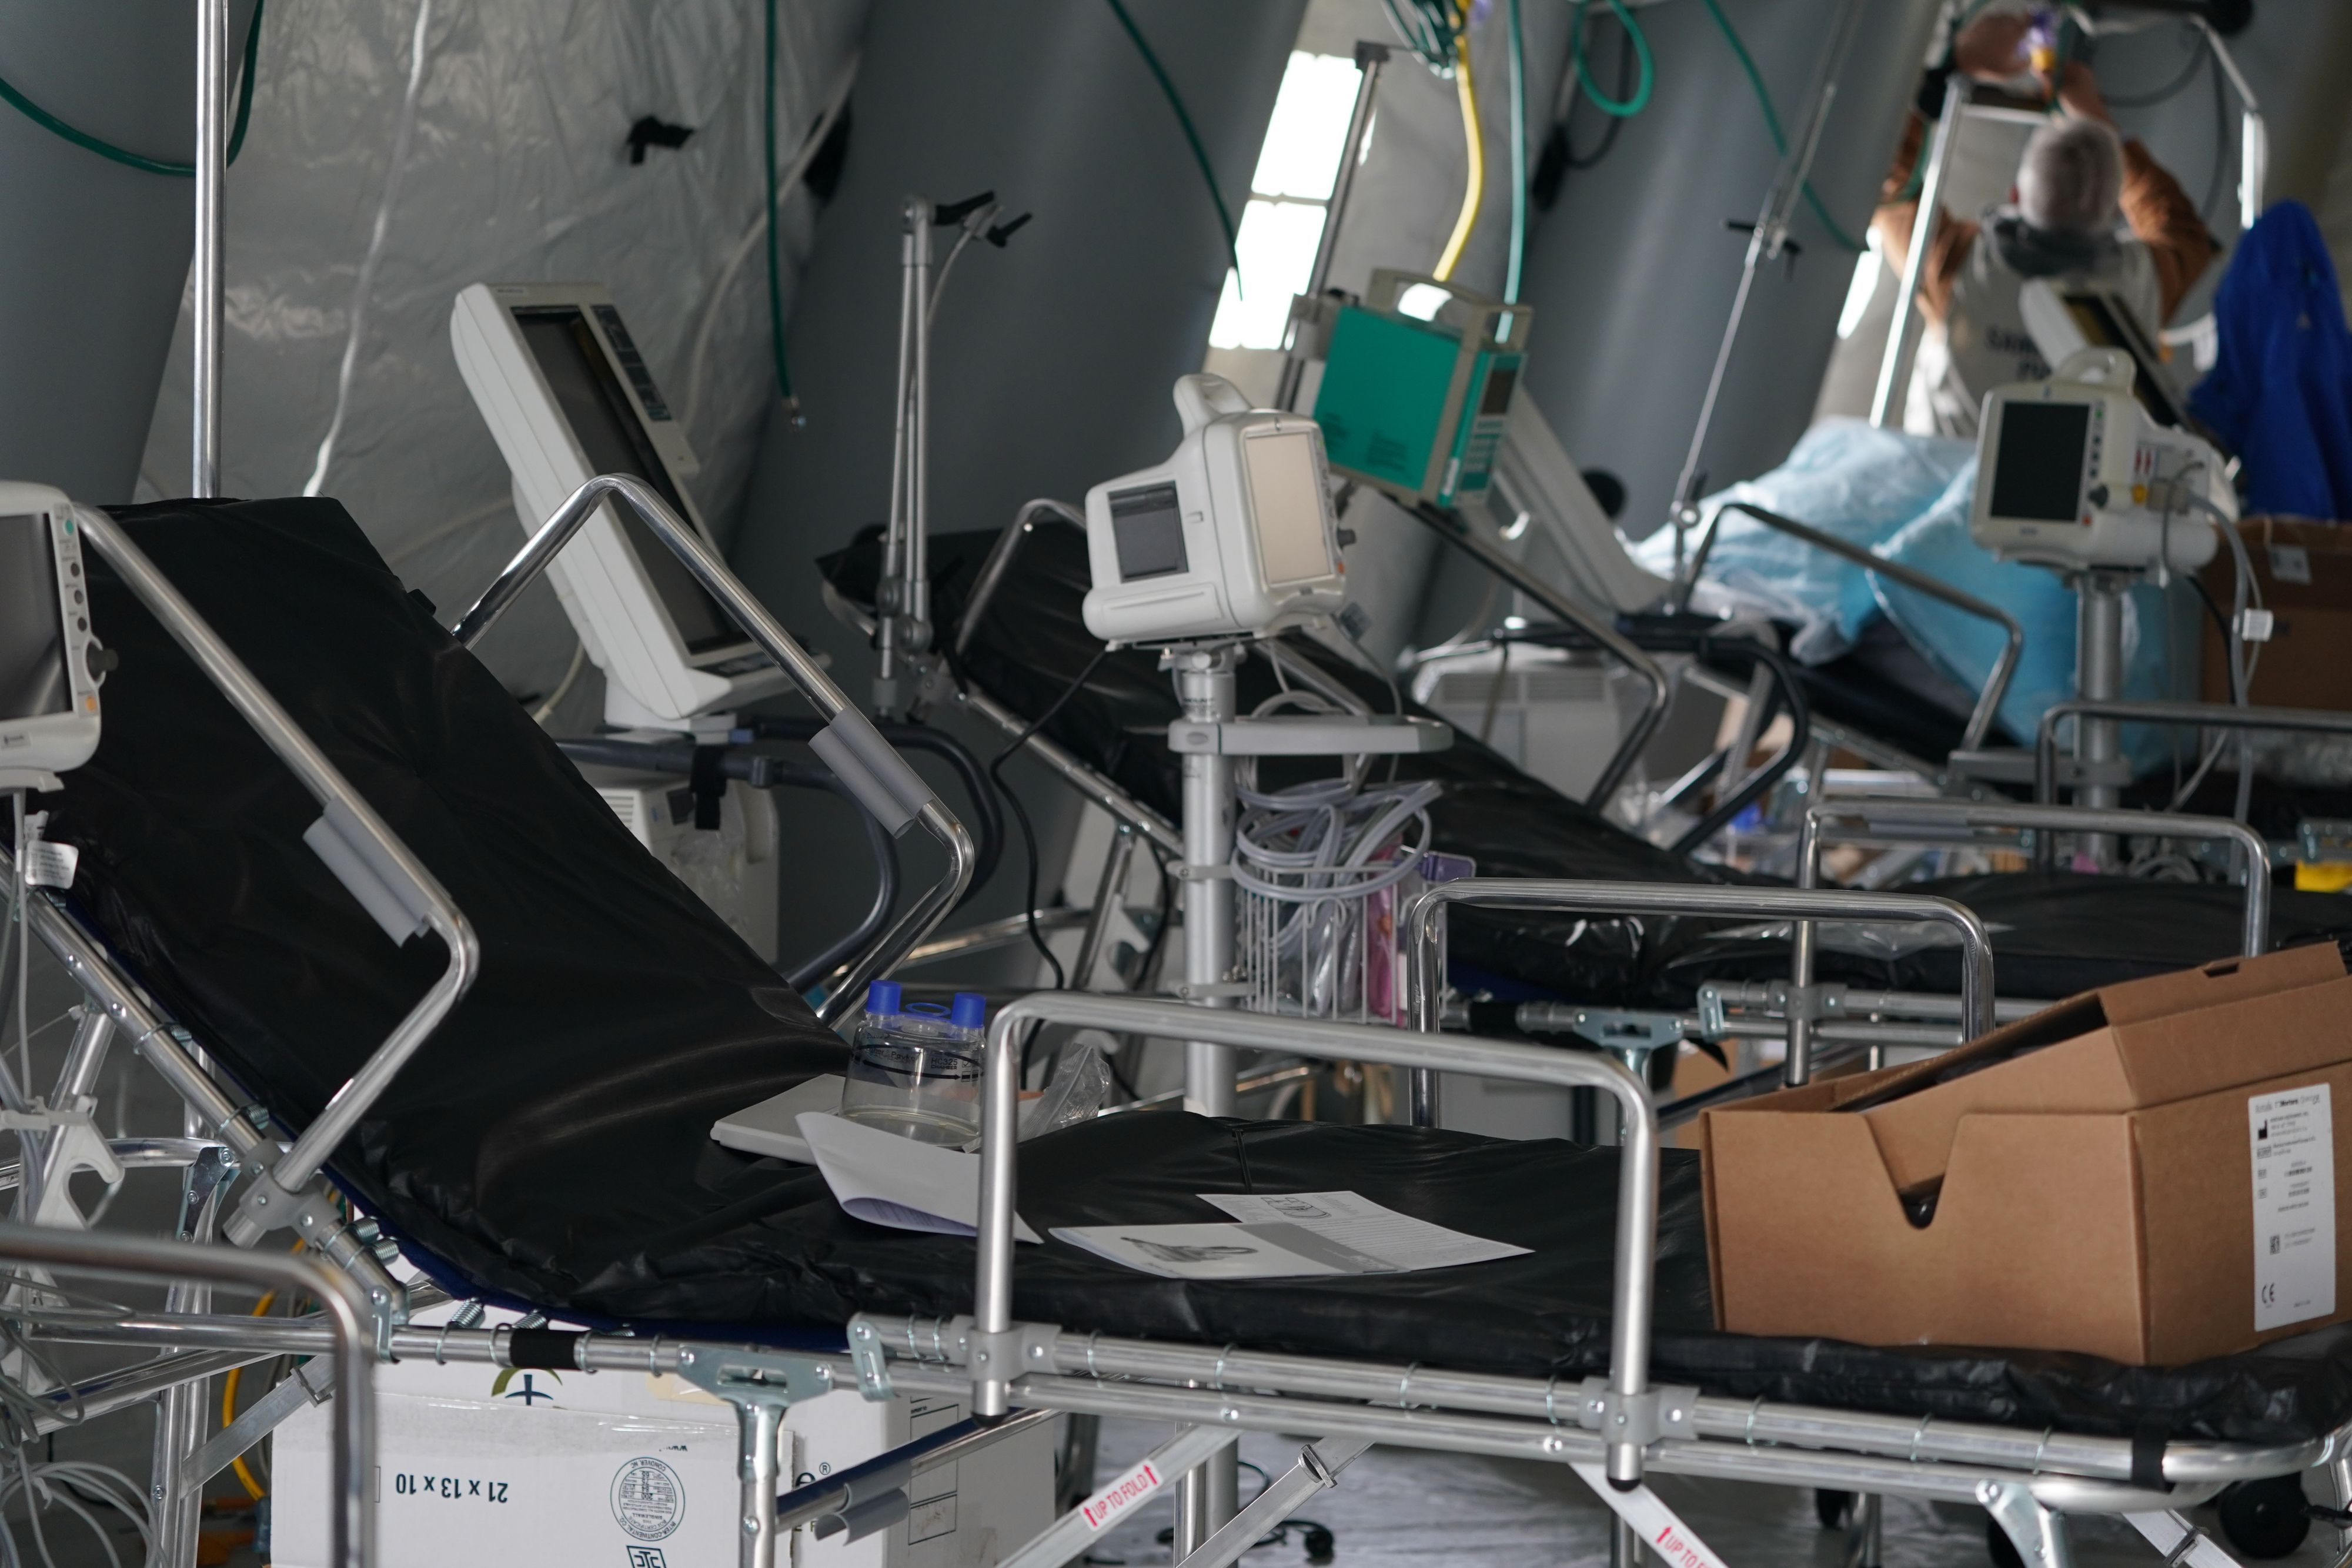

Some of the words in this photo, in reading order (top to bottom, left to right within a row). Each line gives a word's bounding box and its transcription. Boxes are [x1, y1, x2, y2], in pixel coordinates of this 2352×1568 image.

[931, 1058, 958, 1066] HC325
[639, 1460, 666, 1472] CONOVER,
[396, 1473, 416, 1495] 10
[423, 1476, 435, 1492] x
[441, 1477, 462, 1499] 13
[469, 1480, 480, 1496] x
[489, 1482, 508, 1503] 21
[1091, 1500, 1107, 1519] UP
[1107, 1491, 1124, 1510] TO
[1120, 1474, 1148, 1500] FOLD
[619, 1516, 627, 1526] CO.
[628, 1516, 657, 1530] CERTIFICATE
[627, 1521, 676, 1539] INTER-CONTINENTAL
[1665, 1535, 1684, 1553] UP
[1679, 1549, 1698, 1568] TO
